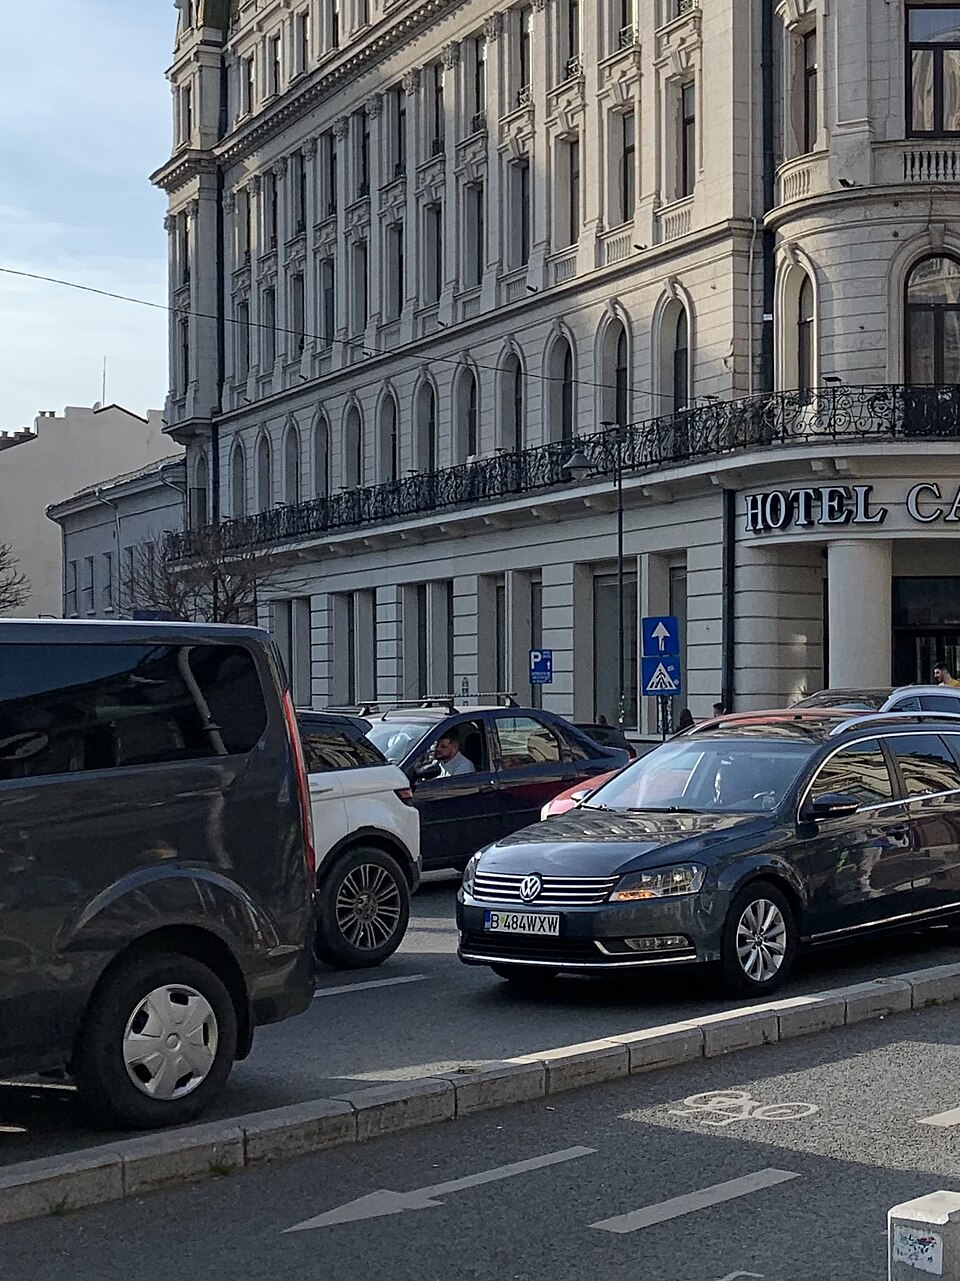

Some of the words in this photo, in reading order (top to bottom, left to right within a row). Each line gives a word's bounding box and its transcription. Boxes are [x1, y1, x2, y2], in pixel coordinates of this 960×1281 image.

[745, 485, 888, 532] HOTEL
[531, 651, 542, 670] P
[490, 913, 500, 929] B
